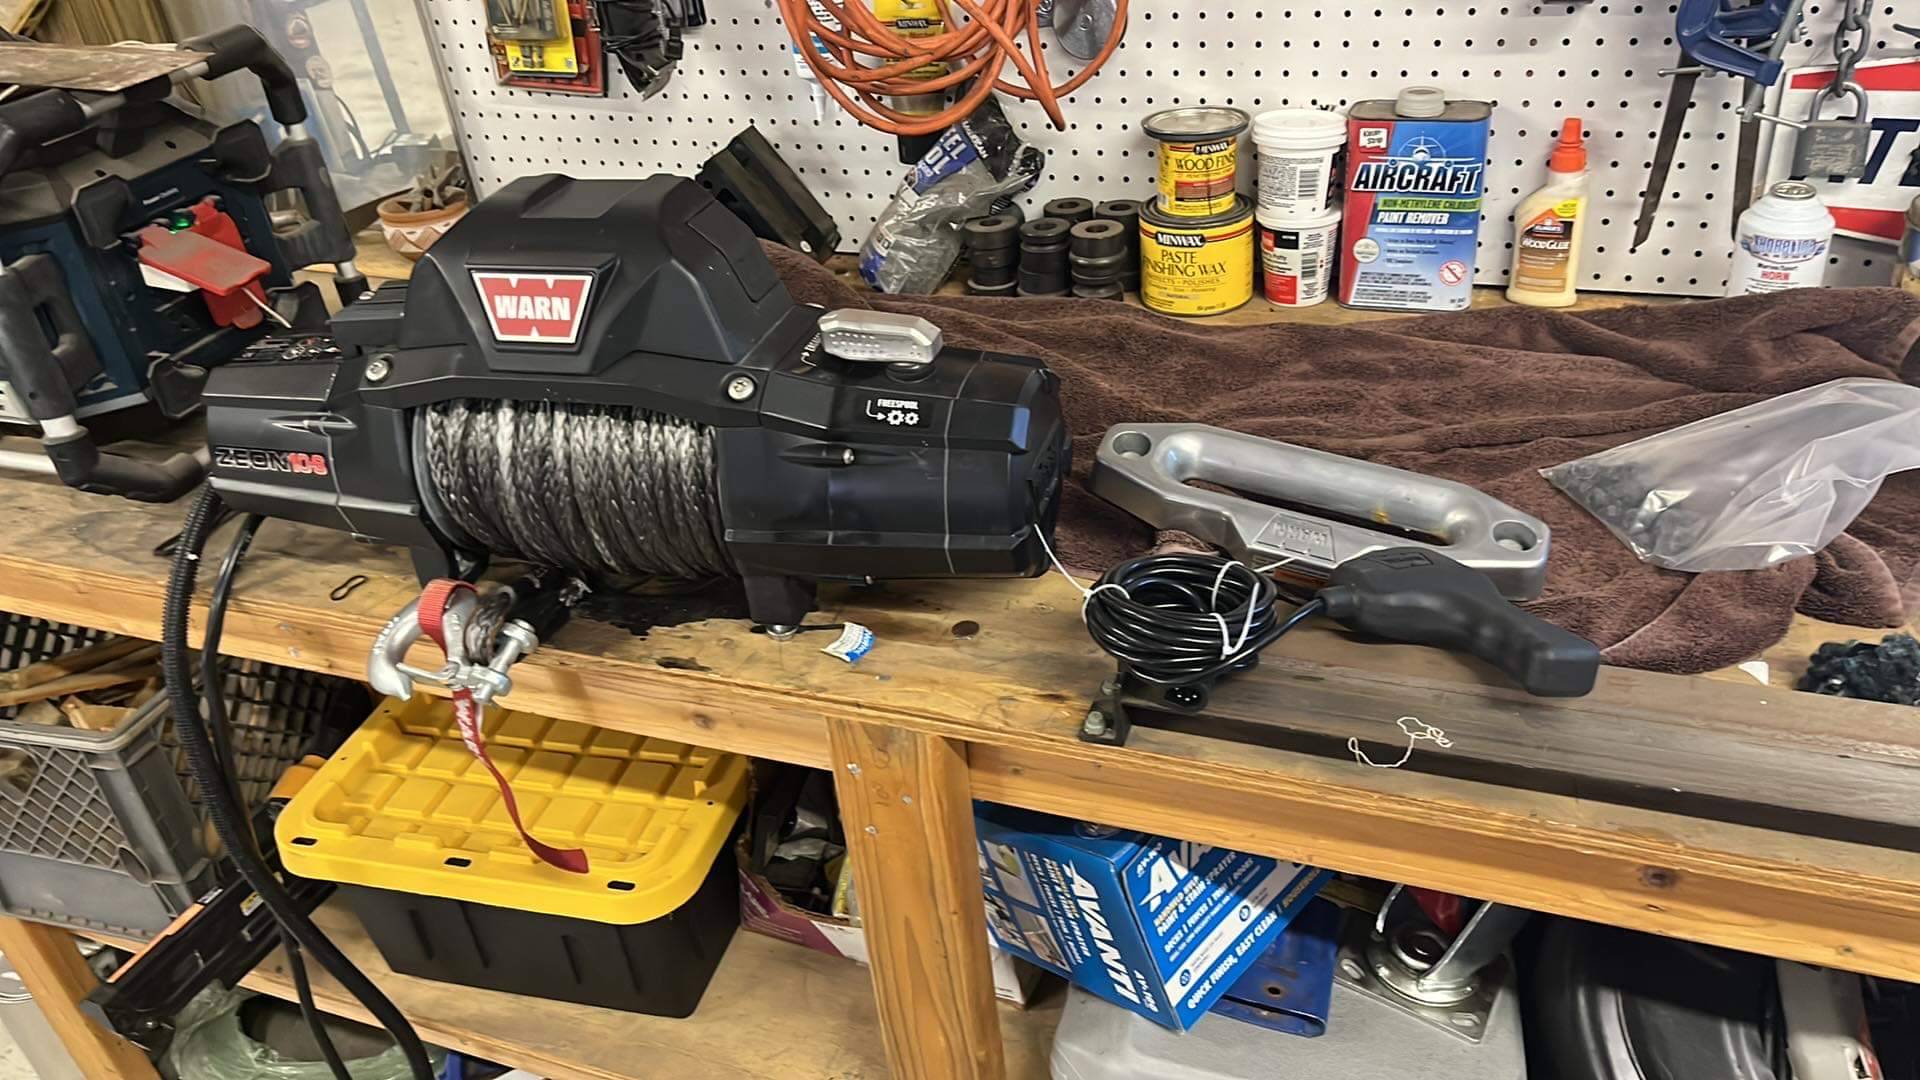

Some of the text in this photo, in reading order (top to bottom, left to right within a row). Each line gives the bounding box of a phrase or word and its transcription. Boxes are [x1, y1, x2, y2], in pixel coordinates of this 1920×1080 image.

[1175, 157, 1215, 171] WOOD
[1351, 162, 1482, 194] AIRCRAFT
[1381, 199, 1442, 209] NON-METHYLENE
[1377, 212, 1450, 225] PAINT REMOVER
[1157, 232, 1203, 247] MINWAX
[1161, 249, 1198, 265] PASTE
[1198, 261, 1227, 276] WAX
[494, 295, 571, 320] WARN
[877, 398, 919, 410] FREESPOOL
[1157, 910, 1179, 936] PAINT
[1186, 880, 1206, 905] STAIN
[1205, 852, 1237, 885] SPRAYER
[1063, 859, 1141, 1004] AVANTI
[1187, 980, 1212, 1009] QUICK
[1235, 933, 1256, 957] EASY
[1255, 910, 1278, 937] CLEAN
